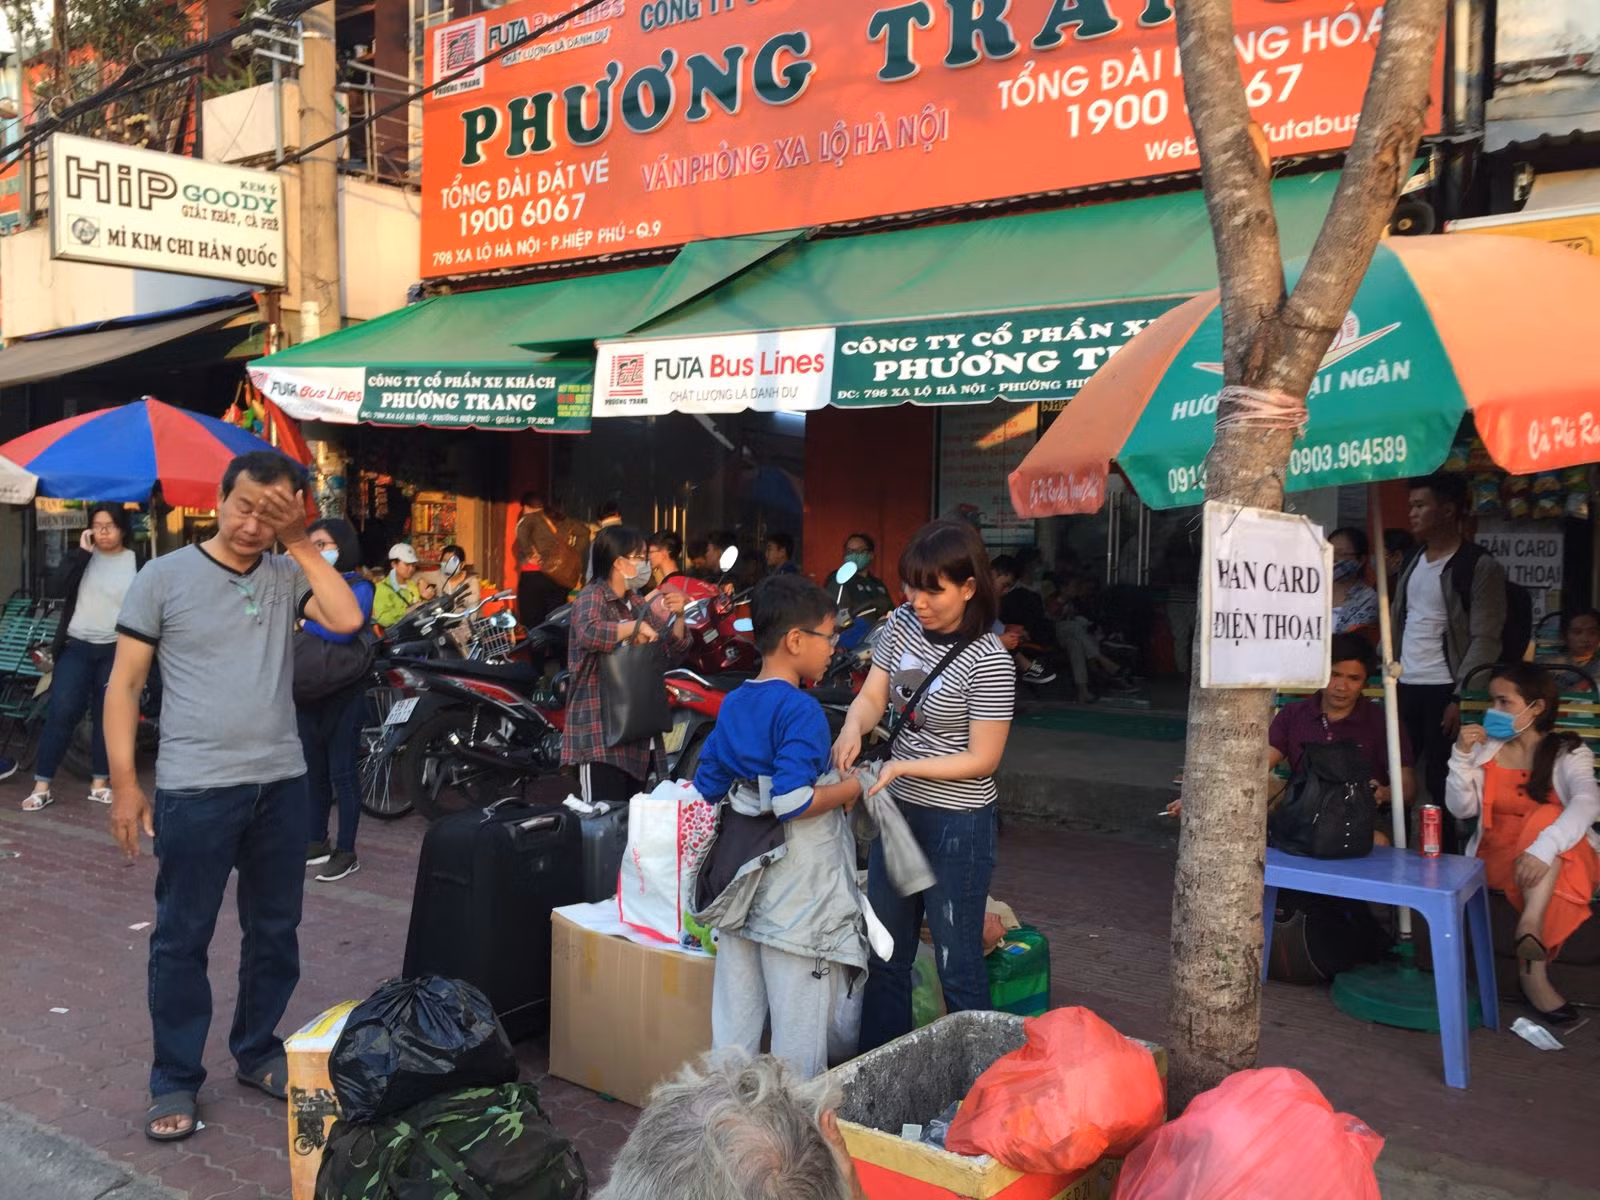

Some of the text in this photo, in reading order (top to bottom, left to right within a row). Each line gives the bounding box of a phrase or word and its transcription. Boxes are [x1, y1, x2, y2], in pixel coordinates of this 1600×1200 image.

[488, 18, 529, 50] FUTA
[997, 60, 1089, 110] TỔNG
[1100, 46, 1161, 91] ĐÀI
[460, 31, 817, 167] PHƯƠNG
[1067, 88, 1168, 138] 1900
[774, 136, 811, 172] XA
[818, 120, 851, 168] LỘ
[853, 111, 893, 156] HÀ
[896, 101, 950, 153] NỘI
[441, 152, 610, 210] TỔNG ĐÀI ĐẶT VÉ
[182, 184, 278, 214] GOODY
[459, 192, 587, 237] 1900 6067
[131, 233, 163, 253] KIM
[166, 236, 194, 257] CHI
[198, 238, 233, 261] HÀN
[236, 242, 278, 268] QUỐC
[456, 248, 474, 265] XA
[495, 239, 513, 258] HÀ
[517, 235, 541, 258] NỘI
[840, 316, 1158, 356] CÔNG TY CỔ PHẦN X
[368, 370, 557, 389] CÔNG TY CỔ PHẦN XE KHÁCH
[655, 356, 704, 381] FUTA
[709, 353, 754, 378] Bus
[759, 350, 825, 376] Lines
[873, 350, 1061, 381] PHƯƠNG
[1339, 359, 1411, 391] NGÀN
[270, 381, 363, 402] FUTA Bus Lines
[380, 389, 457, 411] PHƯƠNG
[463, 392, 537, 412] TRANG
[750, 386, 779, 400] DANH
[891, 387, 910, 398] XA
[1290, 434, 1407, 476] 0903.964589
[1514, 539, 1558, 557] CARD
[1264, 562, 1321, 594] CARD
[1213, 608, 1323, 647] ĐIỆN THOẠI
